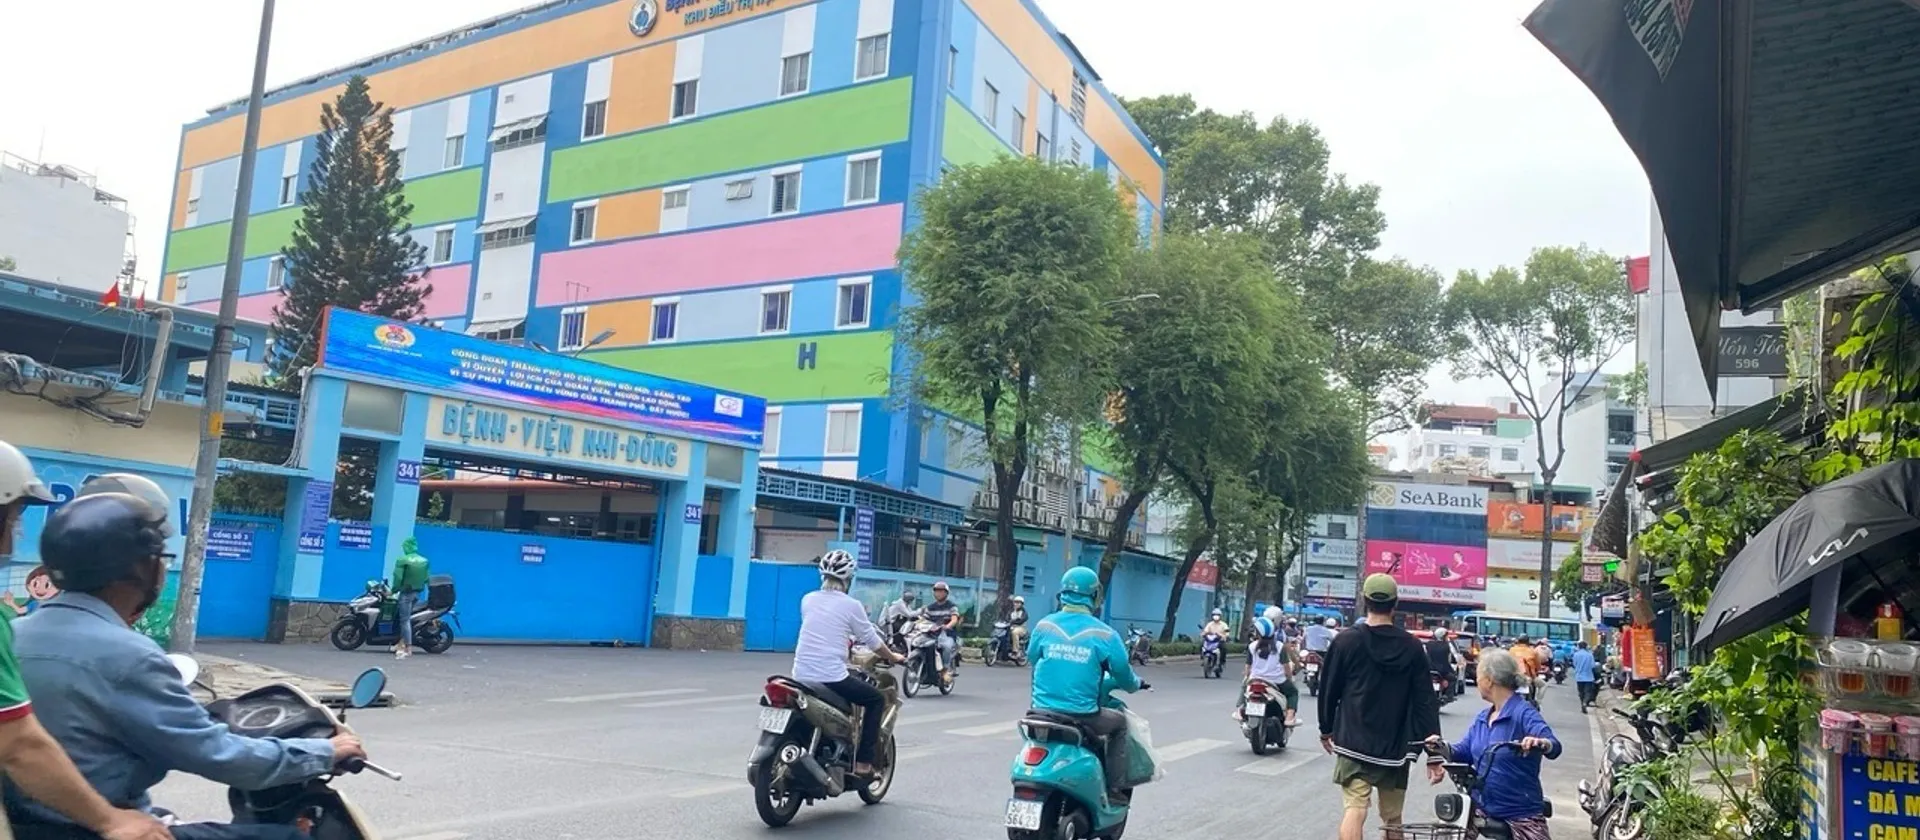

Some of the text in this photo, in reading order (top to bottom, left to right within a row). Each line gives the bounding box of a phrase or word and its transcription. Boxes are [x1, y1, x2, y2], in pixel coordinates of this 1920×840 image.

[798, 342, 817, 370] H
[1753, 334, 1784, 356] Tóc
[451, 348, 479, 360] CÔNG
[481, 354, 508, 367] ĐOÀN
[511, 359, 542, 374] THÀNH
[543, 367, 562, 379] PHỐ
[563, 371, 576, 381] HỒ
[577, 374, 592, 384] CHÍ
[594, 378, 617, 389] MINH
[1735, 358, 1760, 369] 596
[461, 360, 471, 369] VÌ
[544, 375, 563, 387] CỦA
[565, 380, 589, 392] ĐOÀN
[641, 395, 657, 405] LAO
[477, 374, 503, 386] PHÁT
[505, 378, 533, 391] TRIỂN
[534, 383, 554, 395] BỀN
[554, 387, 579, 400] VỮNG
[580, 392, 599, 403] CỦA
[600, 396, 628, 408] THÀNH
[399, 463, 420, 479] 341
[1400, 489, 1484, 508] SeABank
[686, 506, 702, 519] 341
[1442, 591, 1474, 600] SeABank
[1867, 759, 1920, 784] CAFE
[1868, 789, 1899, 815] ĐÁ
[1869, 823, 1918, 840] CAM
